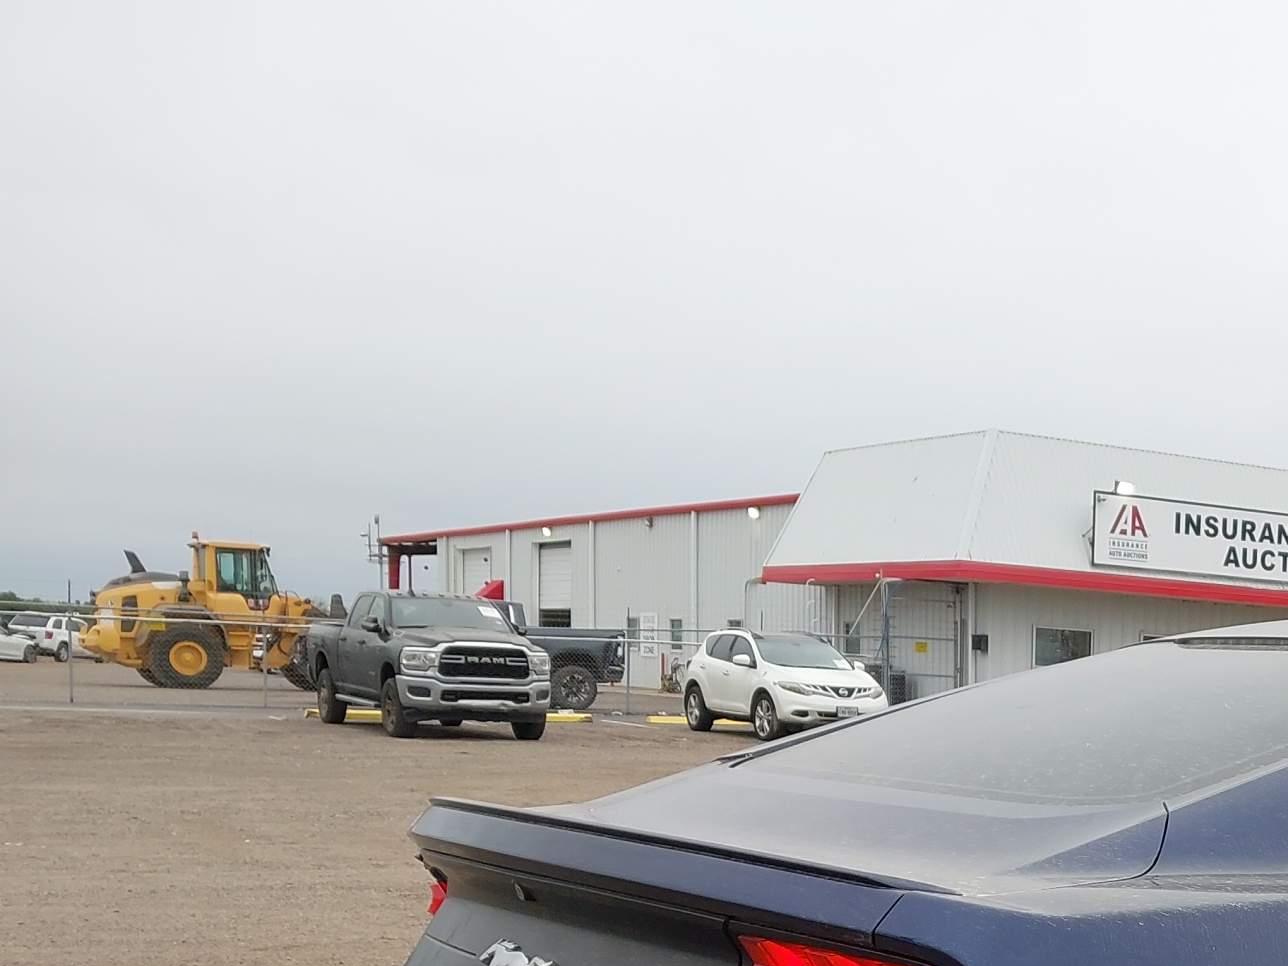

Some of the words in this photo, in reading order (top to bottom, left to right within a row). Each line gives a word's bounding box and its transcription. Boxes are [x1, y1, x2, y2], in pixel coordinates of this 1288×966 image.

[1109, 540, 1148, 550] INSURANCE
[1123, 551, 1148, 560] AUCTIONS
[465, 656, 505, 664] RAM
